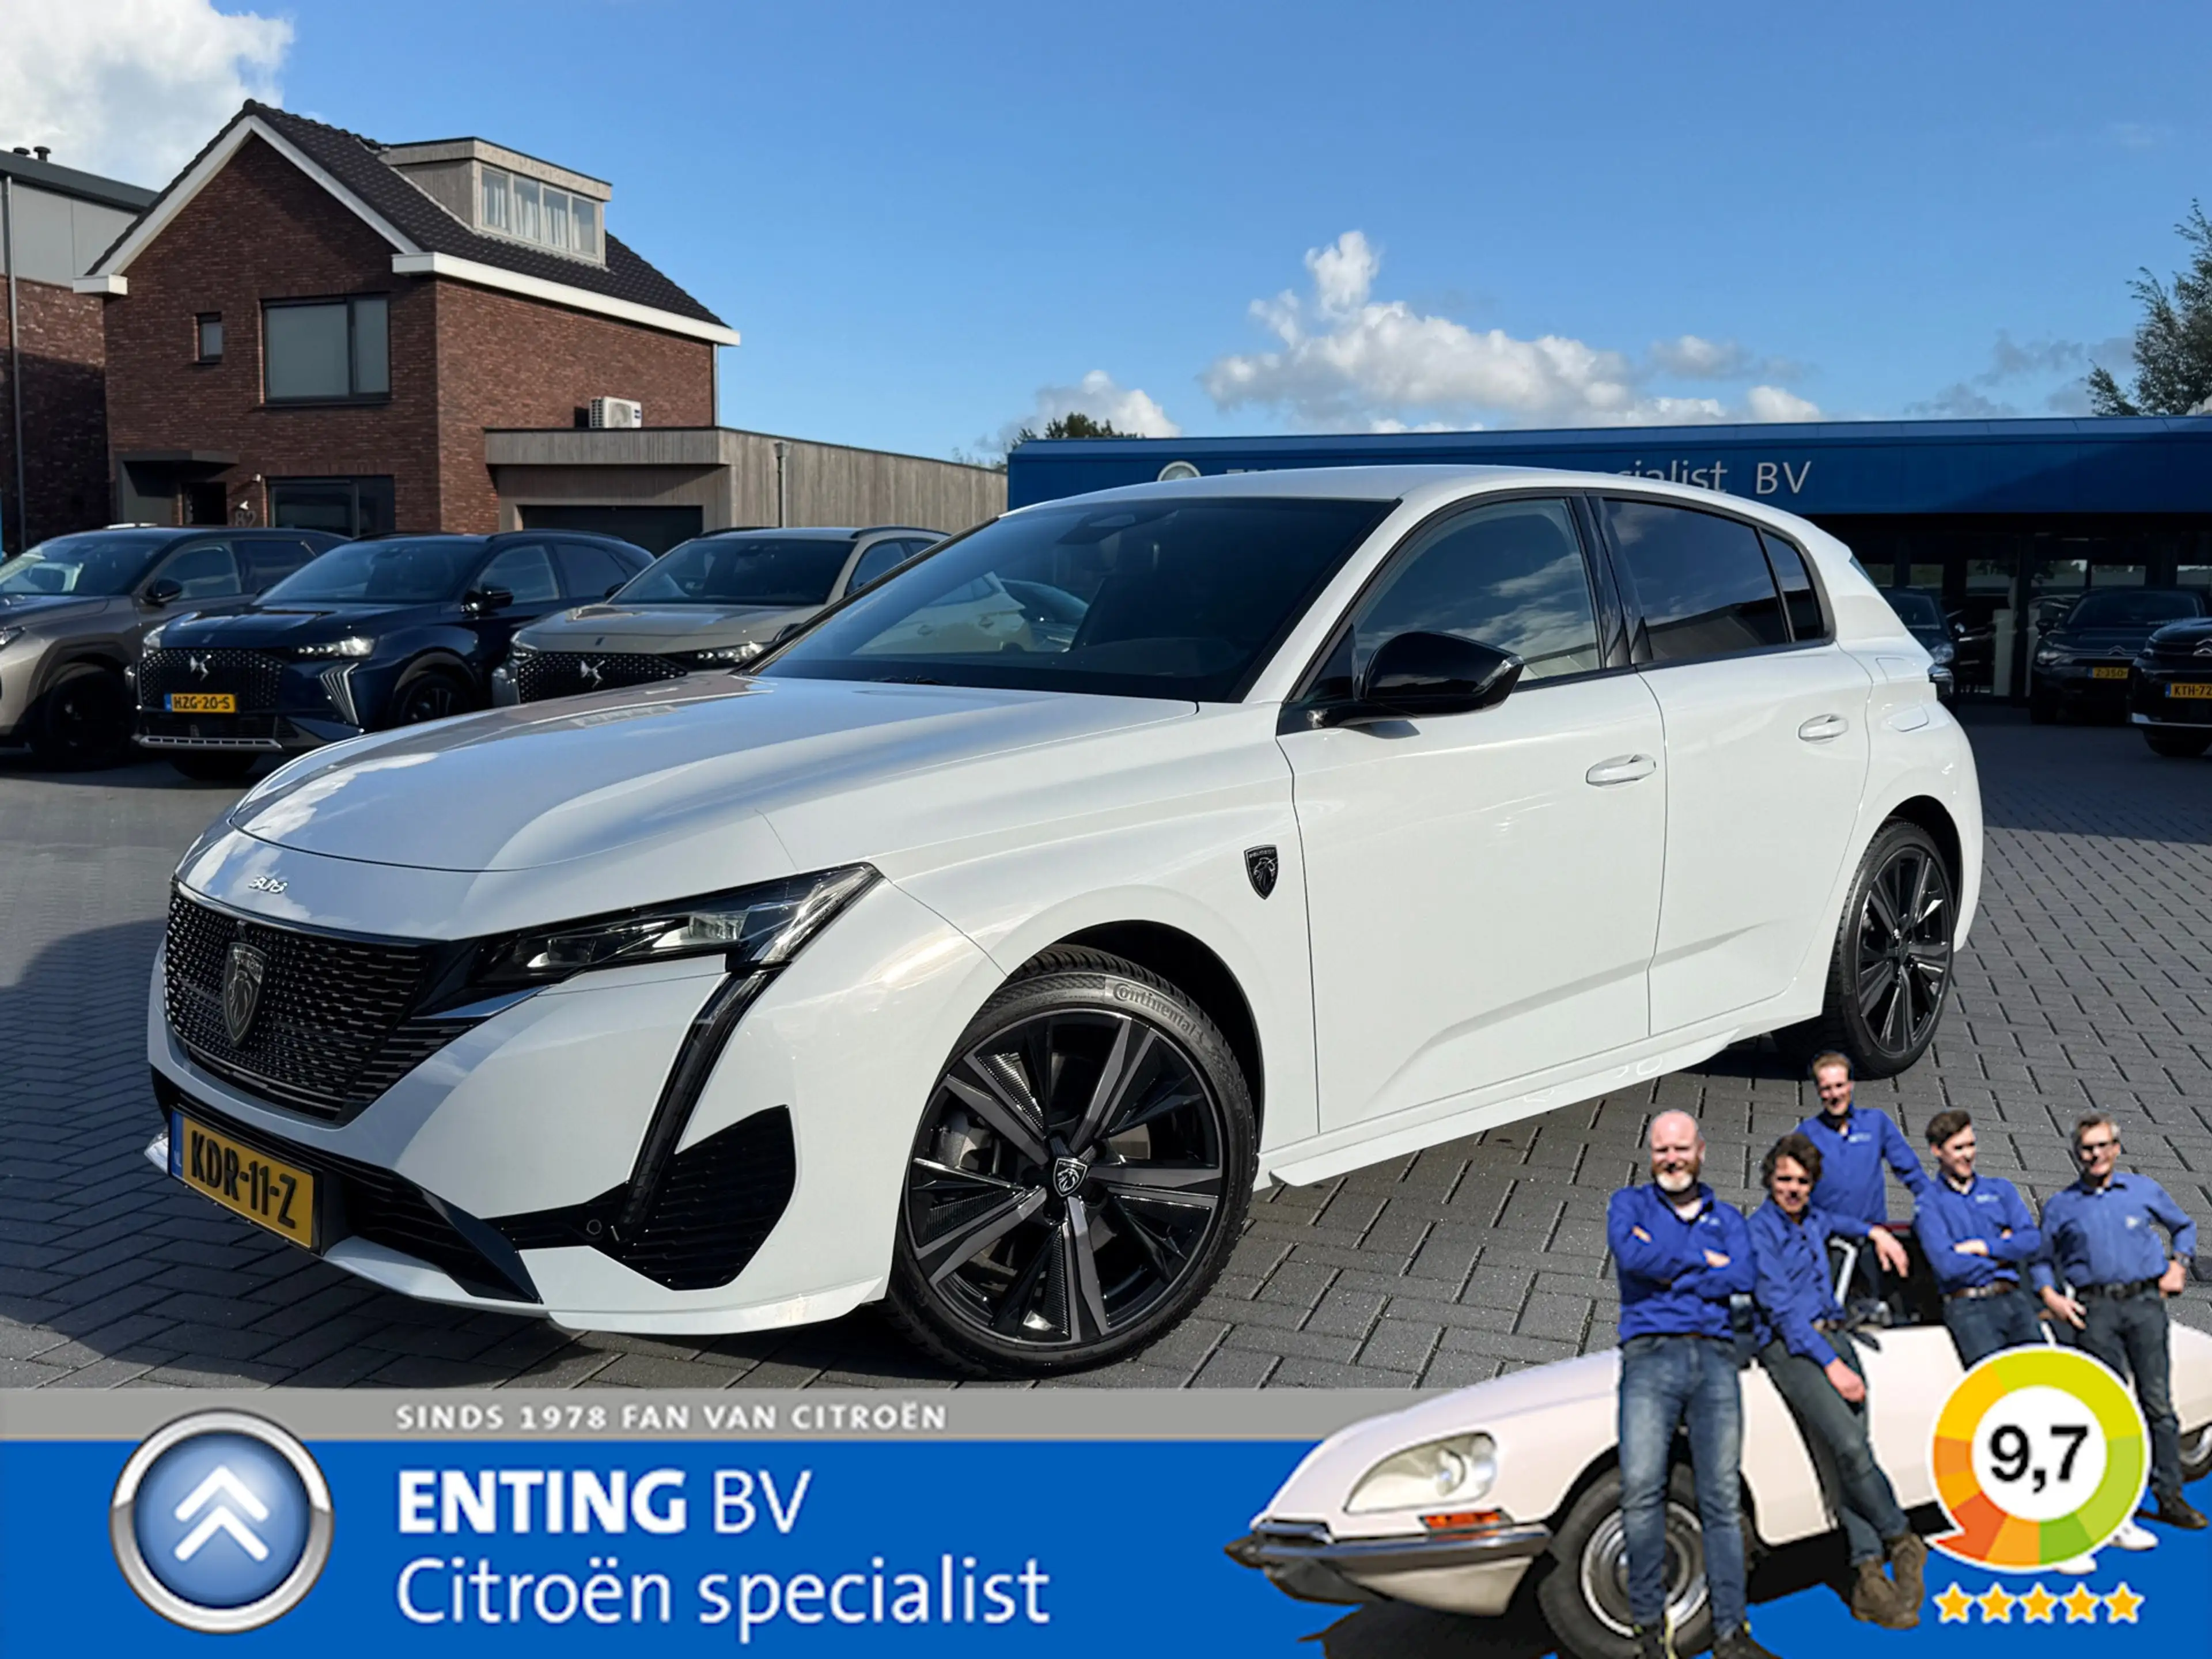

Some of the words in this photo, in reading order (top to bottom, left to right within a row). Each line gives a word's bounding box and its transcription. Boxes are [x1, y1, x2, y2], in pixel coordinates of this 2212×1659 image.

[1619, 460, 1728, 493] ialist
[1756, 461, 1811, 494] BV
[173, 695, 230, 710] HZG-20-S
[1113, 983, 1198, 1033] Continental
[191, 1130, 297, 1229] KDR-11-Z
